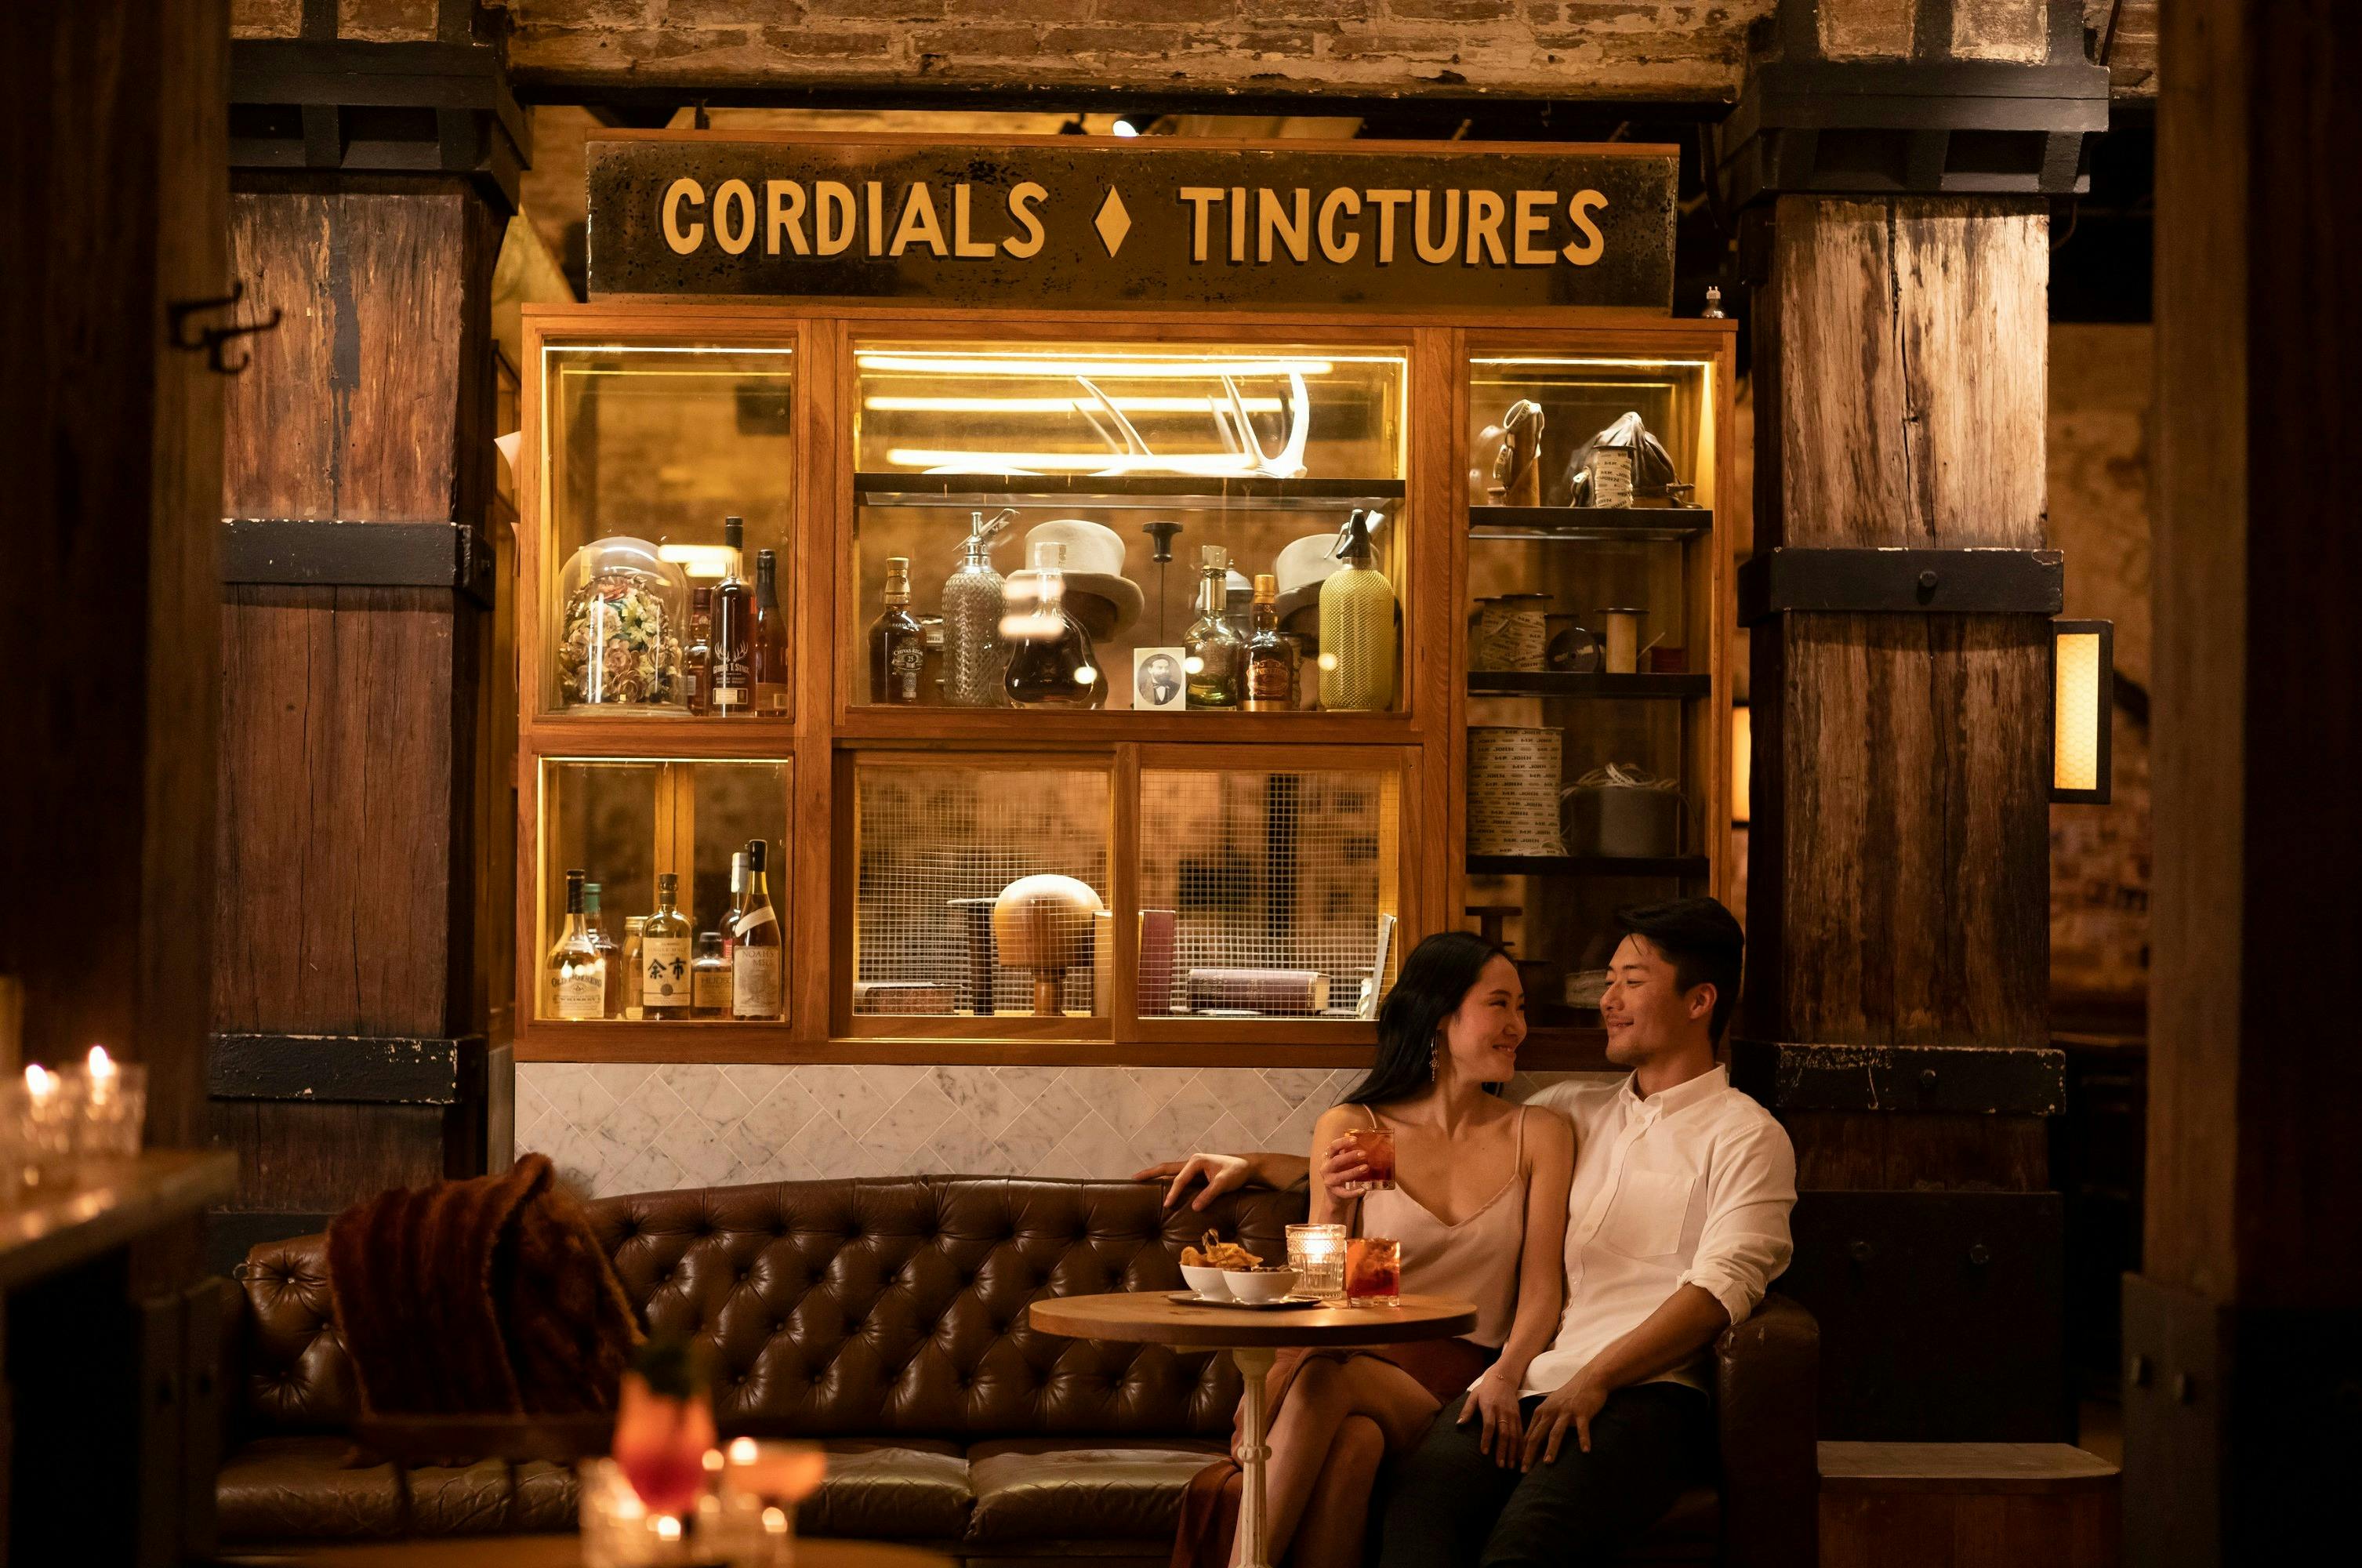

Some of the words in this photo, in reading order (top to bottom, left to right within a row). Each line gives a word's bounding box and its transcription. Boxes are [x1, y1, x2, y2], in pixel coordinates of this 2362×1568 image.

[663, 178, 1047, 258] CORDIALS
[1180, 187, 1607, 265] TINCTURES
[648, 957, 687, 981] 余市
[551, 977, 567, 988] OLD
